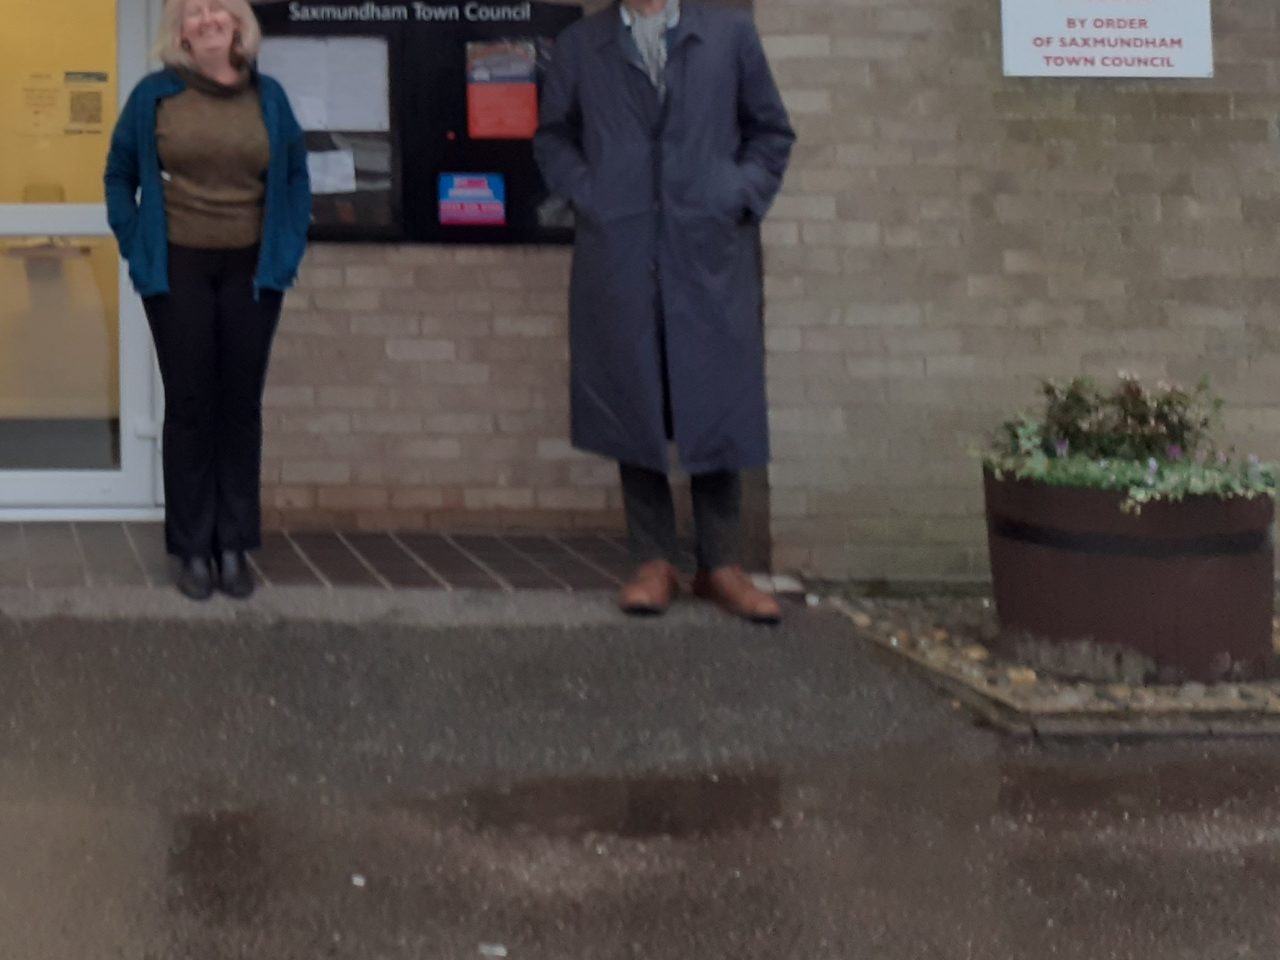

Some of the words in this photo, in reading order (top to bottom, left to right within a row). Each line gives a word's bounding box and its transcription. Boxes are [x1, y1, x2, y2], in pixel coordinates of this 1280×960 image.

[288, 1, 408, 21] Saxmundham
[412, 1, 460, 21] Town
[464, 2, 532, 21] Council
[1066, 18, 1087, 29] BY
[1093, 18, 1149, 29] ORDER
[1033, 37, 1052, 47] OF
[1059, 37, 1183, 48] SAXMUNDHAM
[1043, 56, 1096, 67] TOWN
[1101, 56, 1175, 68] COUNCIL
